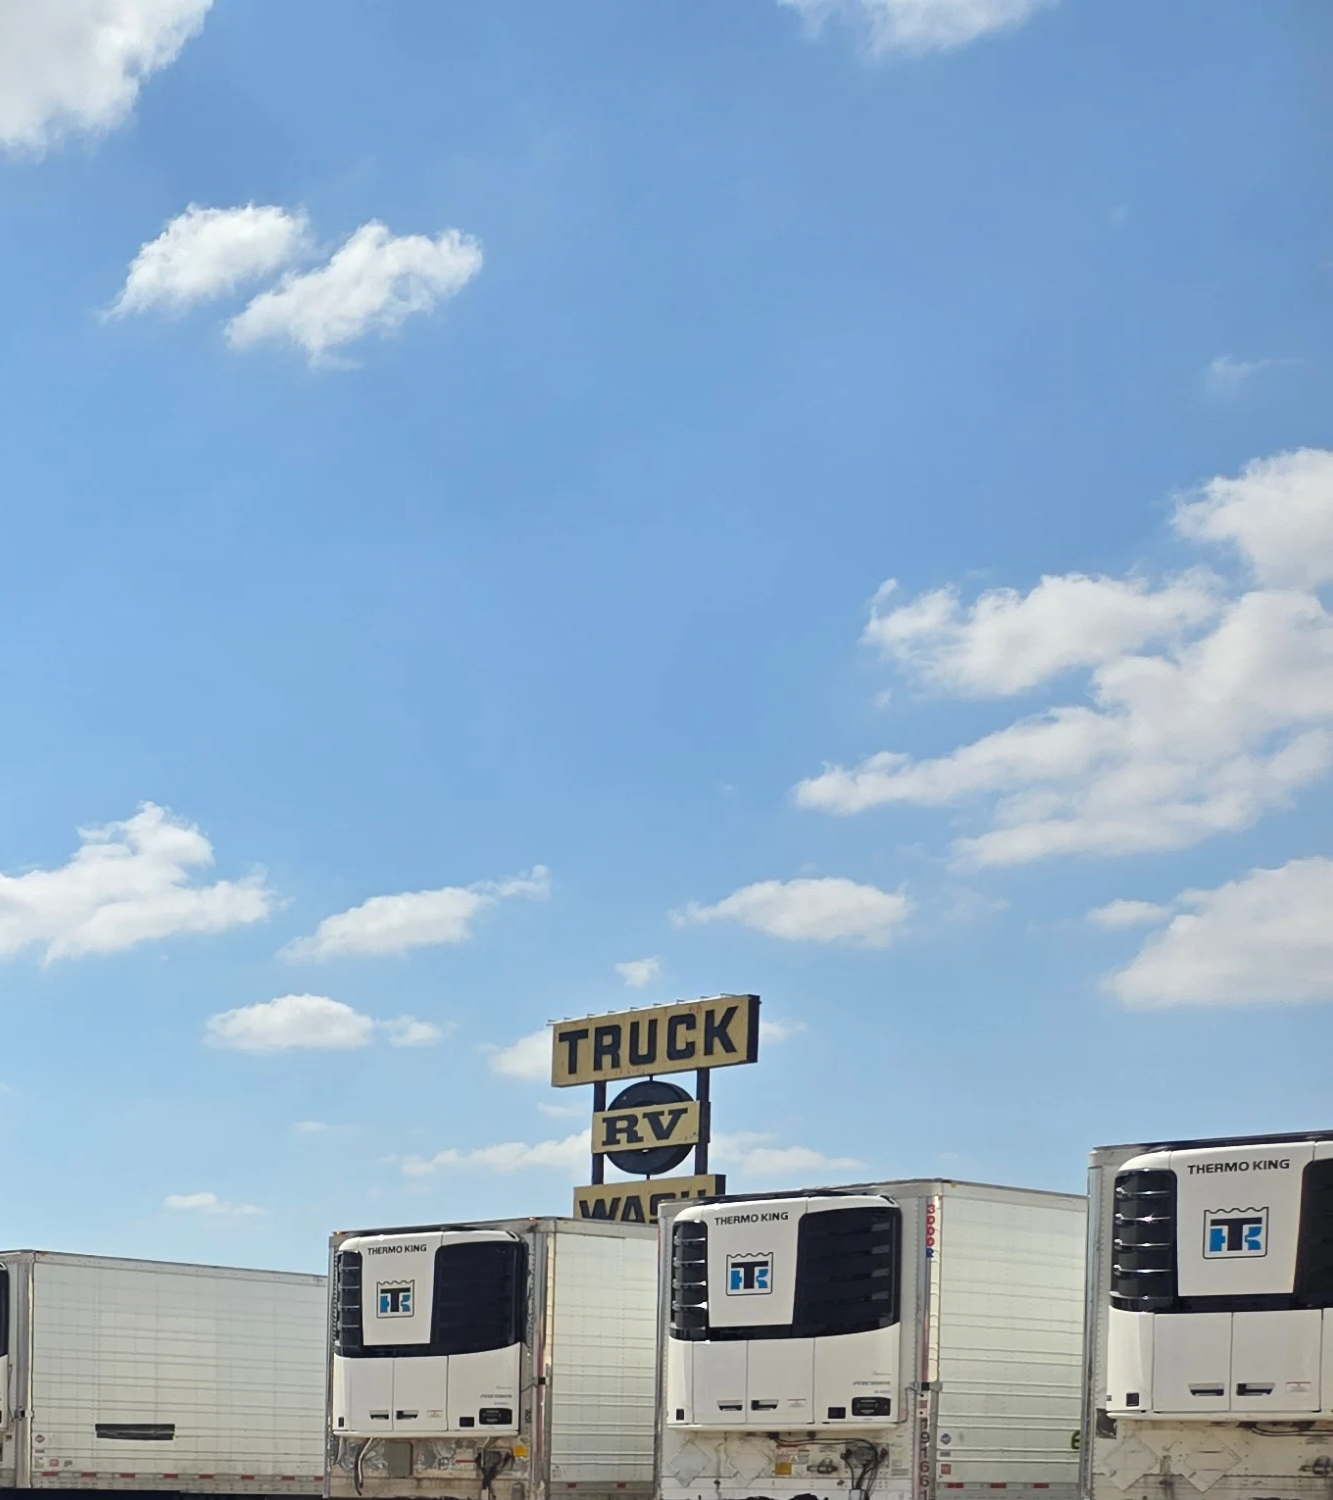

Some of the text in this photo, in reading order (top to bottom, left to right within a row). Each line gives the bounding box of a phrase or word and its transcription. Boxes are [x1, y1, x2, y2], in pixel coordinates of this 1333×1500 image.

[558, 1006, 739, 1075] TRUCK
[601, 1107, 689, 1146] RV
[1187, 1159, 1290, 1175] THERMO KING
[714, 1211, 789, 1226] THERMO KING
[367, 1243, 427, 1255] THERMO KING
